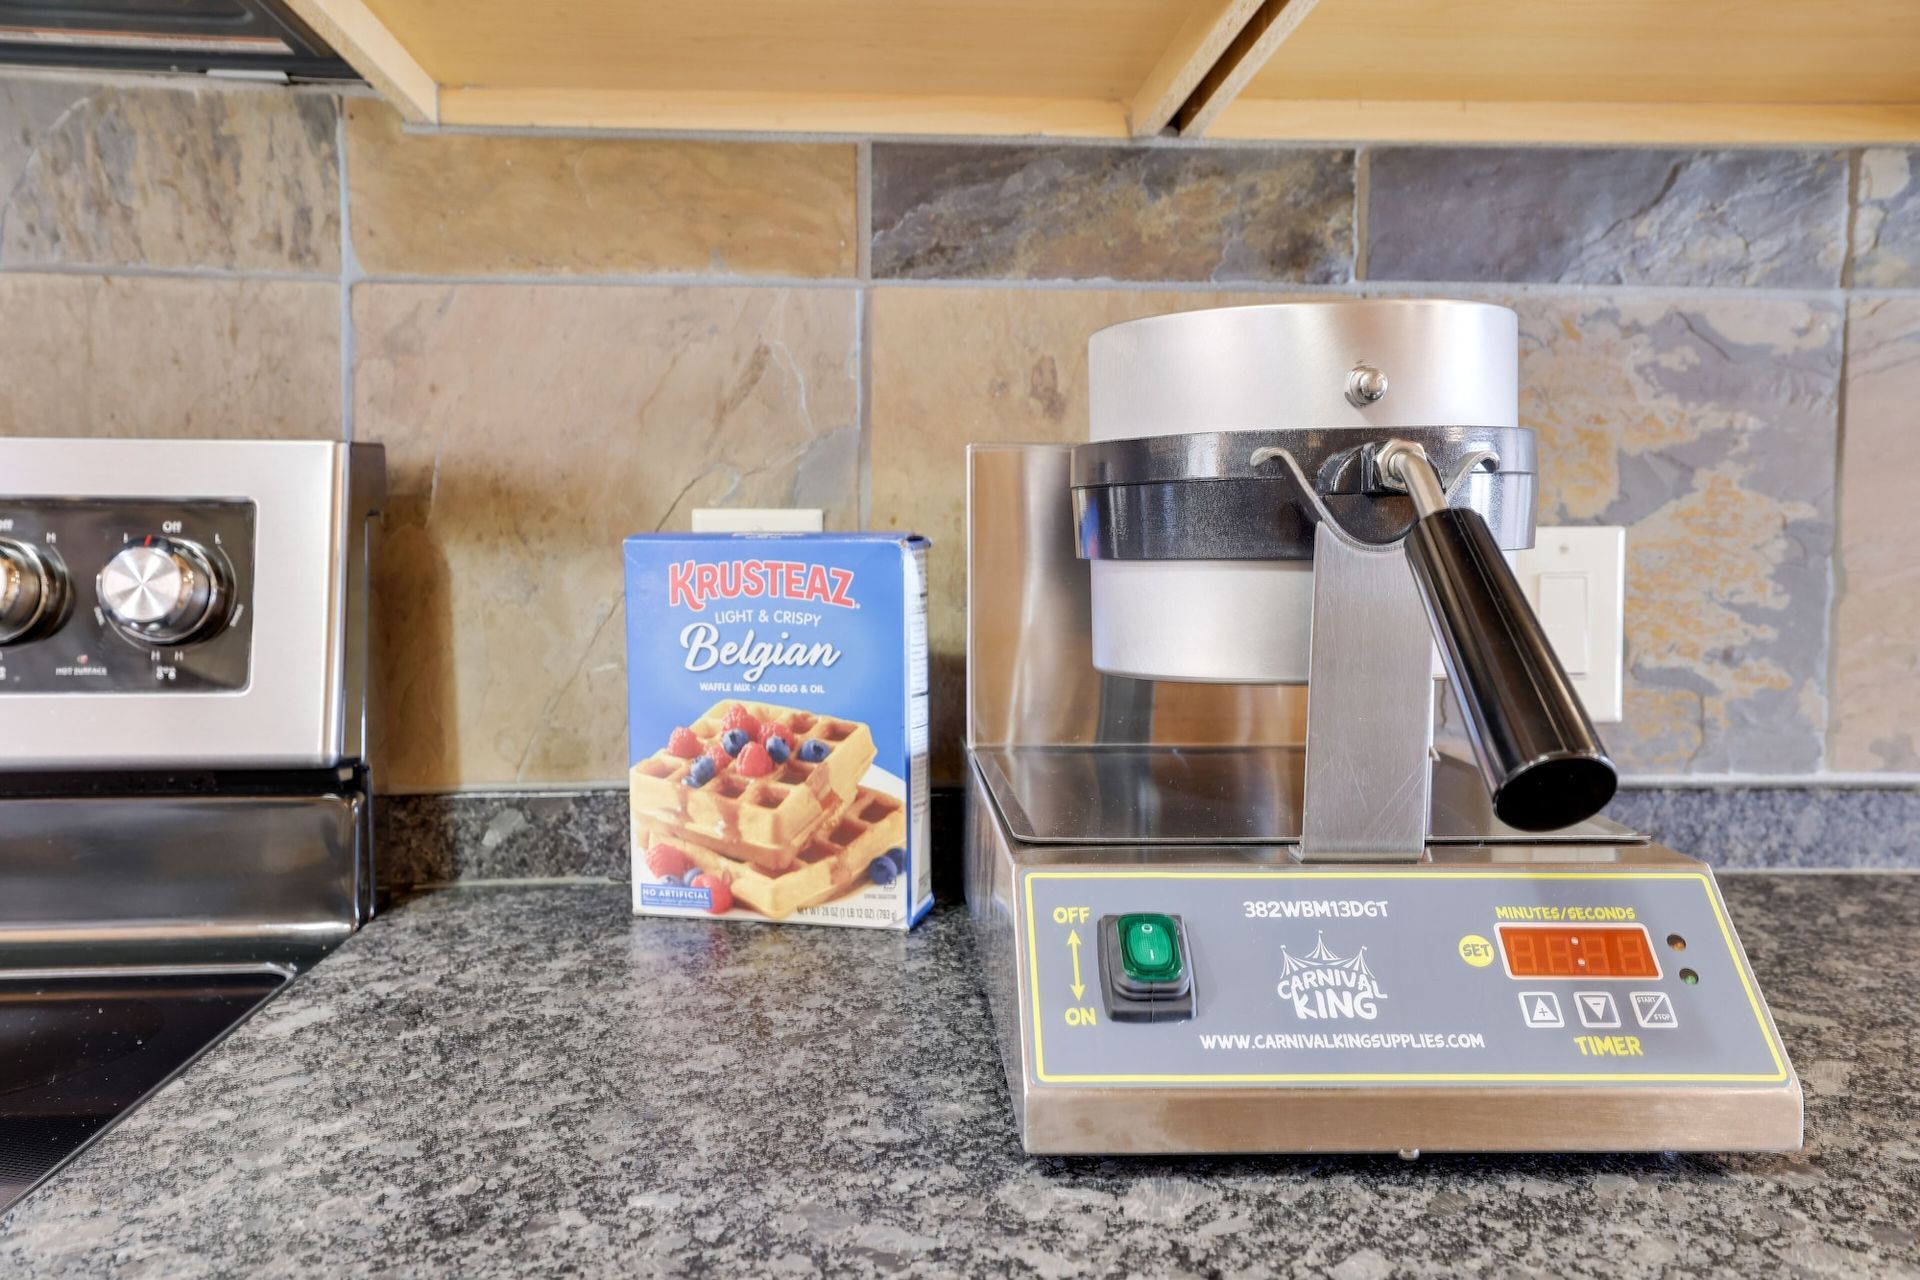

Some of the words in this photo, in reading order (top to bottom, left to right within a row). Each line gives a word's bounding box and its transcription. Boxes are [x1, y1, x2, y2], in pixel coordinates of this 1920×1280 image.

[669, 560, 855, 613] KRUSTEAZ
[715, 610, 754, 625] LIGHT
[758, 610, 770, 623] &
[773, 610, 822, 627] CRISPY
[680, 622, 842, 683] Belgian
[700, 682, 731, 692] WAFFLE
[733, 682, 751, 692] MIX
[757, 683, 777, 693] ADD
[779, 683, 798, 693] EGG
[801, 684, 809, 693] &
[810, 684, 826, 694] OIL
[643, 888, 656, 896] NO
[659, 889, 709, 900] ARTIFICIAL
[1053, 907, 1090, 924] OFF
[1243, 900, 1389, 918] 382WBM13DGT
[1495, 906, 1636, 920] MINUTES/SECONDS
[1462, 943, 1492, 957] SET
[1277, 968, 1388, 1000] CARNIVAL
[1293, 988, 1378, 1020] KING
[1065, 1007, 1097, 1026] ON
[1653, 1013, 1671, 1021] STOP
[1199, 1033, 1486, 1050] WWW.CARNIVALKINGSUPPLIES.COM
[1573, 1036, 1644, 1056] TIMER
